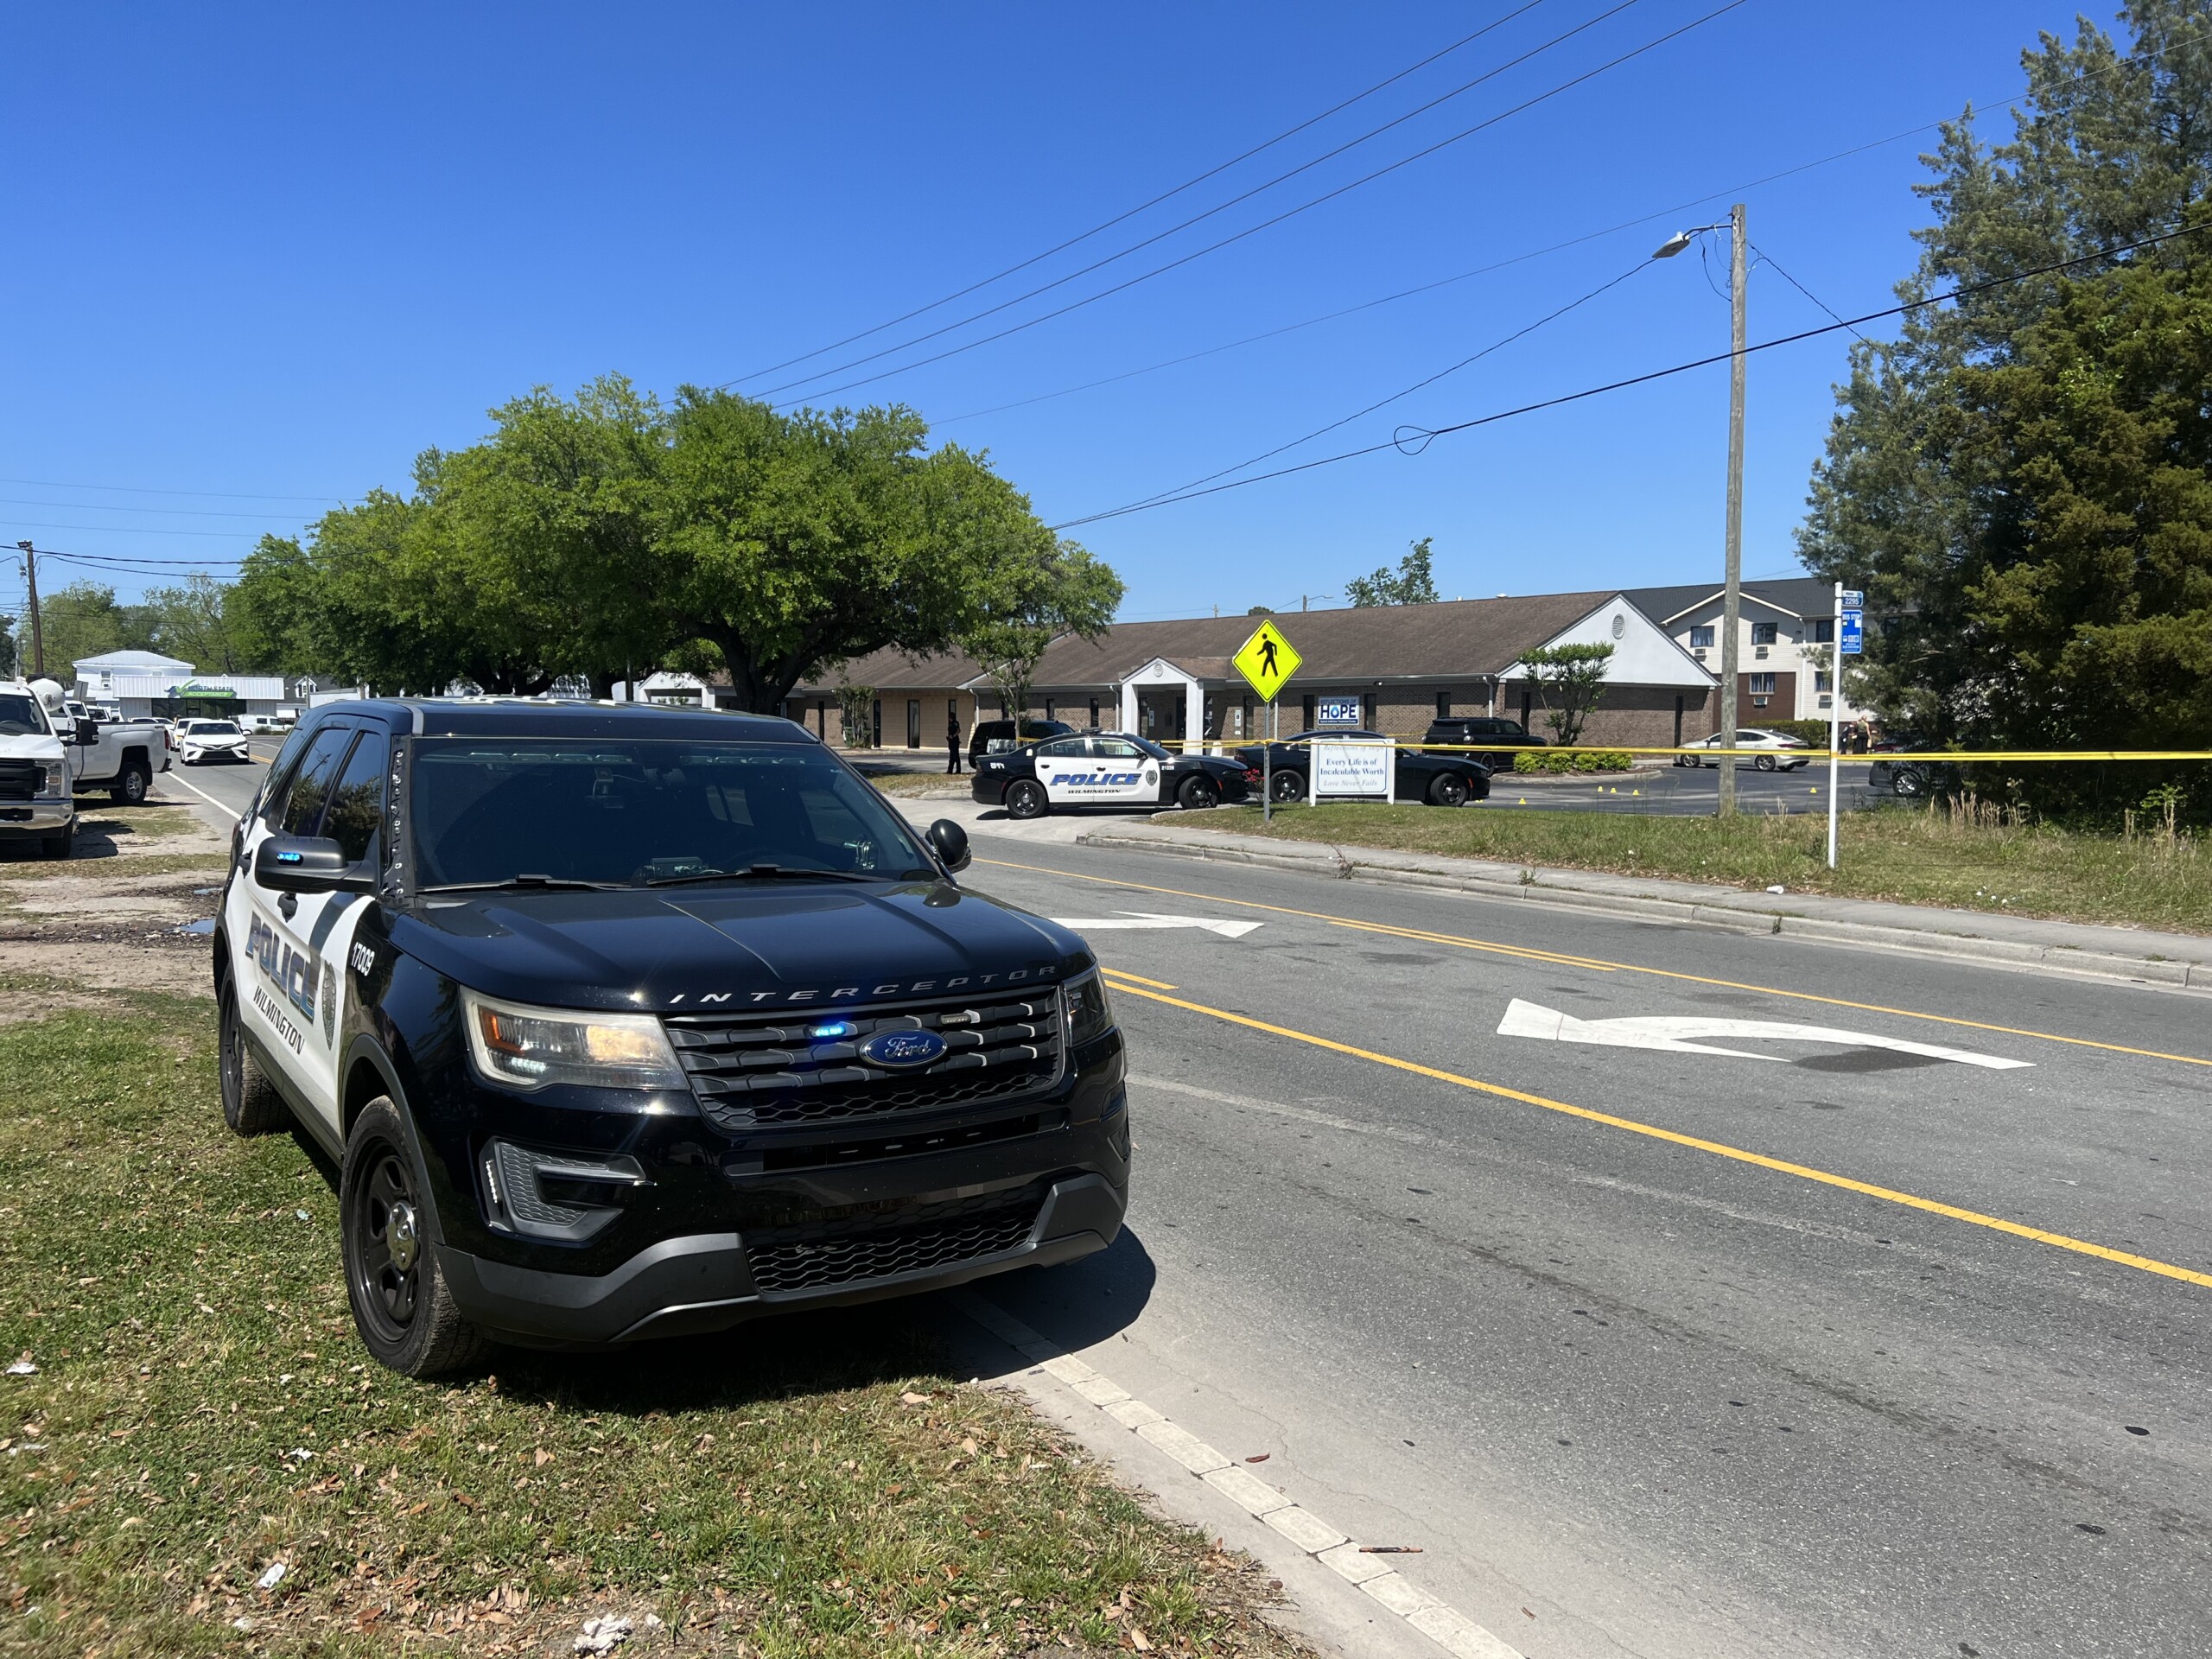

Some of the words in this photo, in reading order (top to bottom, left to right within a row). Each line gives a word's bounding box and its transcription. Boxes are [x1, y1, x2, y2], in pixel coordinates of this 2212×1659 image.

[1320, 704, 1357, 718] HOPE
[1049, 773, 1141, 785] POLICE
[245, 911, 321, 1026] POLICE
[351, 942, 375, 977] 17009
[669, 965, 1056, 1004] INTERCEPTOR
[253, 985, 305, 1056] WILMINGTON
[885, 1036, 931, 1058] Ford
